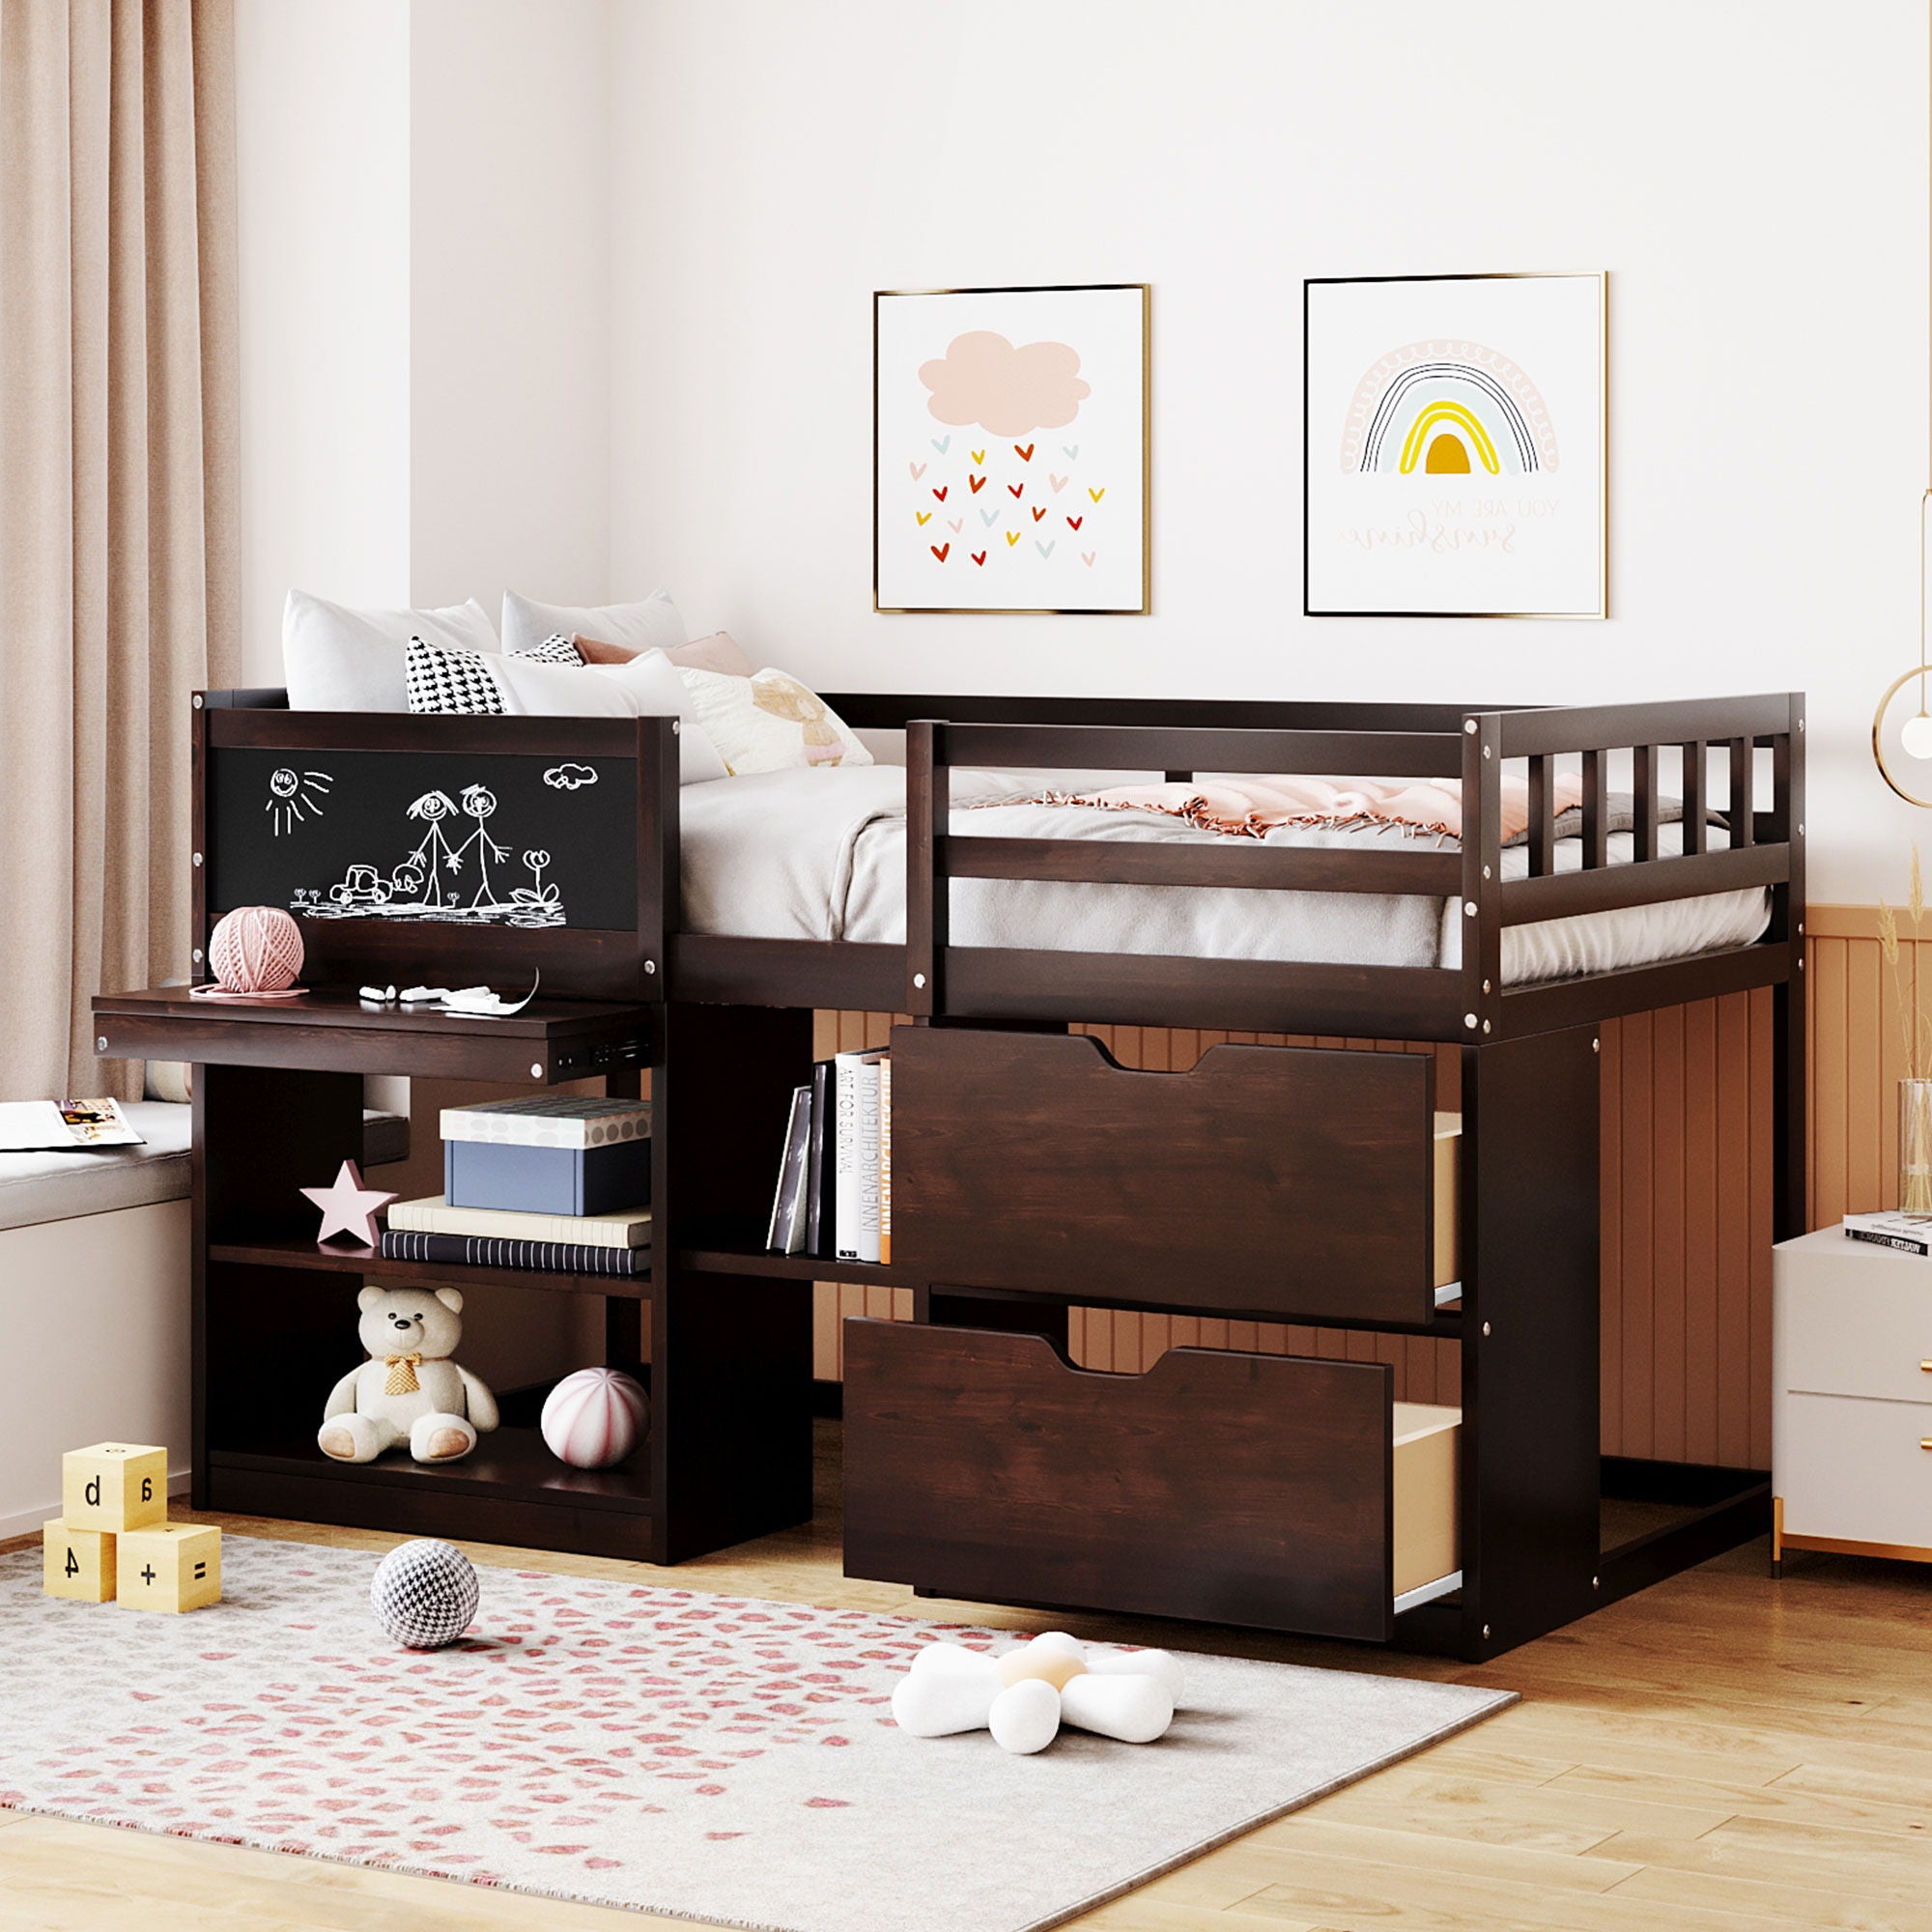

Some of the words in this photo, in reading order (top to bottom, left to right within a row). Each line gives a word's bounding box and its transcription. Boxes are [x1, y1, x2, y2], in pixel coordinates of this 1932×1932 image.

[838, 1067, 855, 1089] ART
[838, 1094, 855, 1118] FOR
[838, 1121, 855, 1175] SURVIVAL
[861, 1075, 879, 1233] INNENARCHITEKTUR
